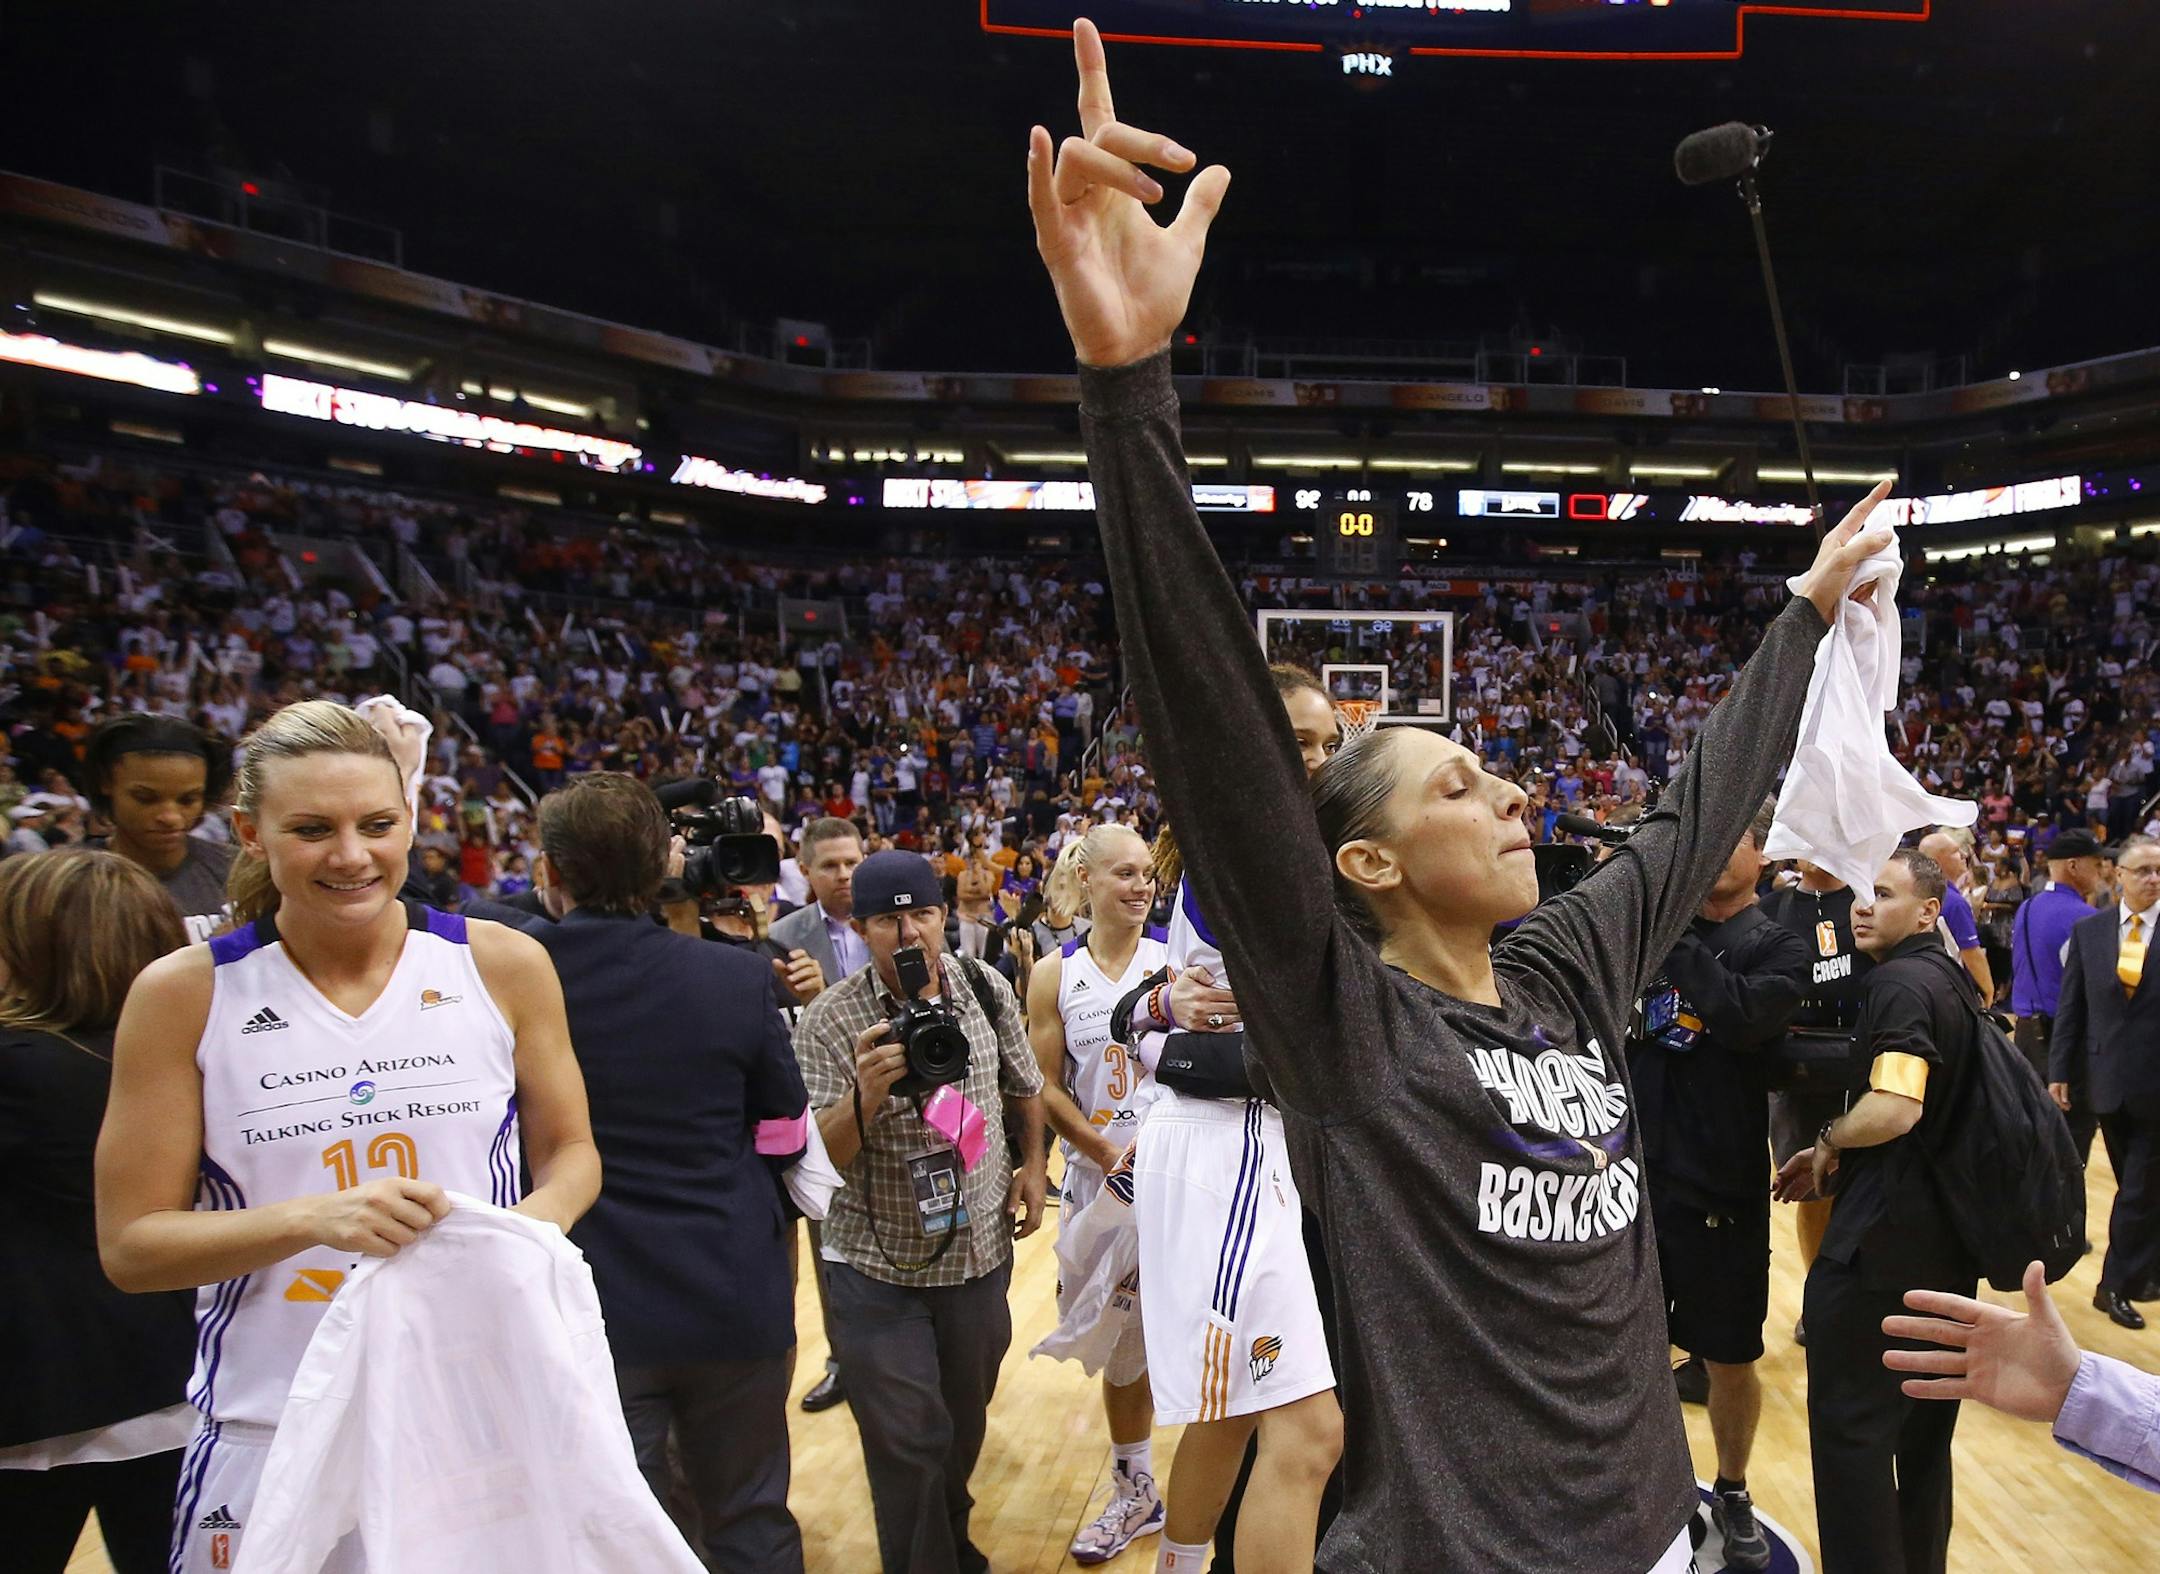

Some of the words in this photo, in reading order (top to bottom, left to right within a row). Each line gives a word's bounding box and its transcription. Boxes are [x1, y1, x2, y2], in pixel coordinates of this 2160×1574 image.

[1341, 53, 1393, 76] PHX
[1406, 491, 1434, 511] 78
[241, 1020, 289, 1034] adidas
